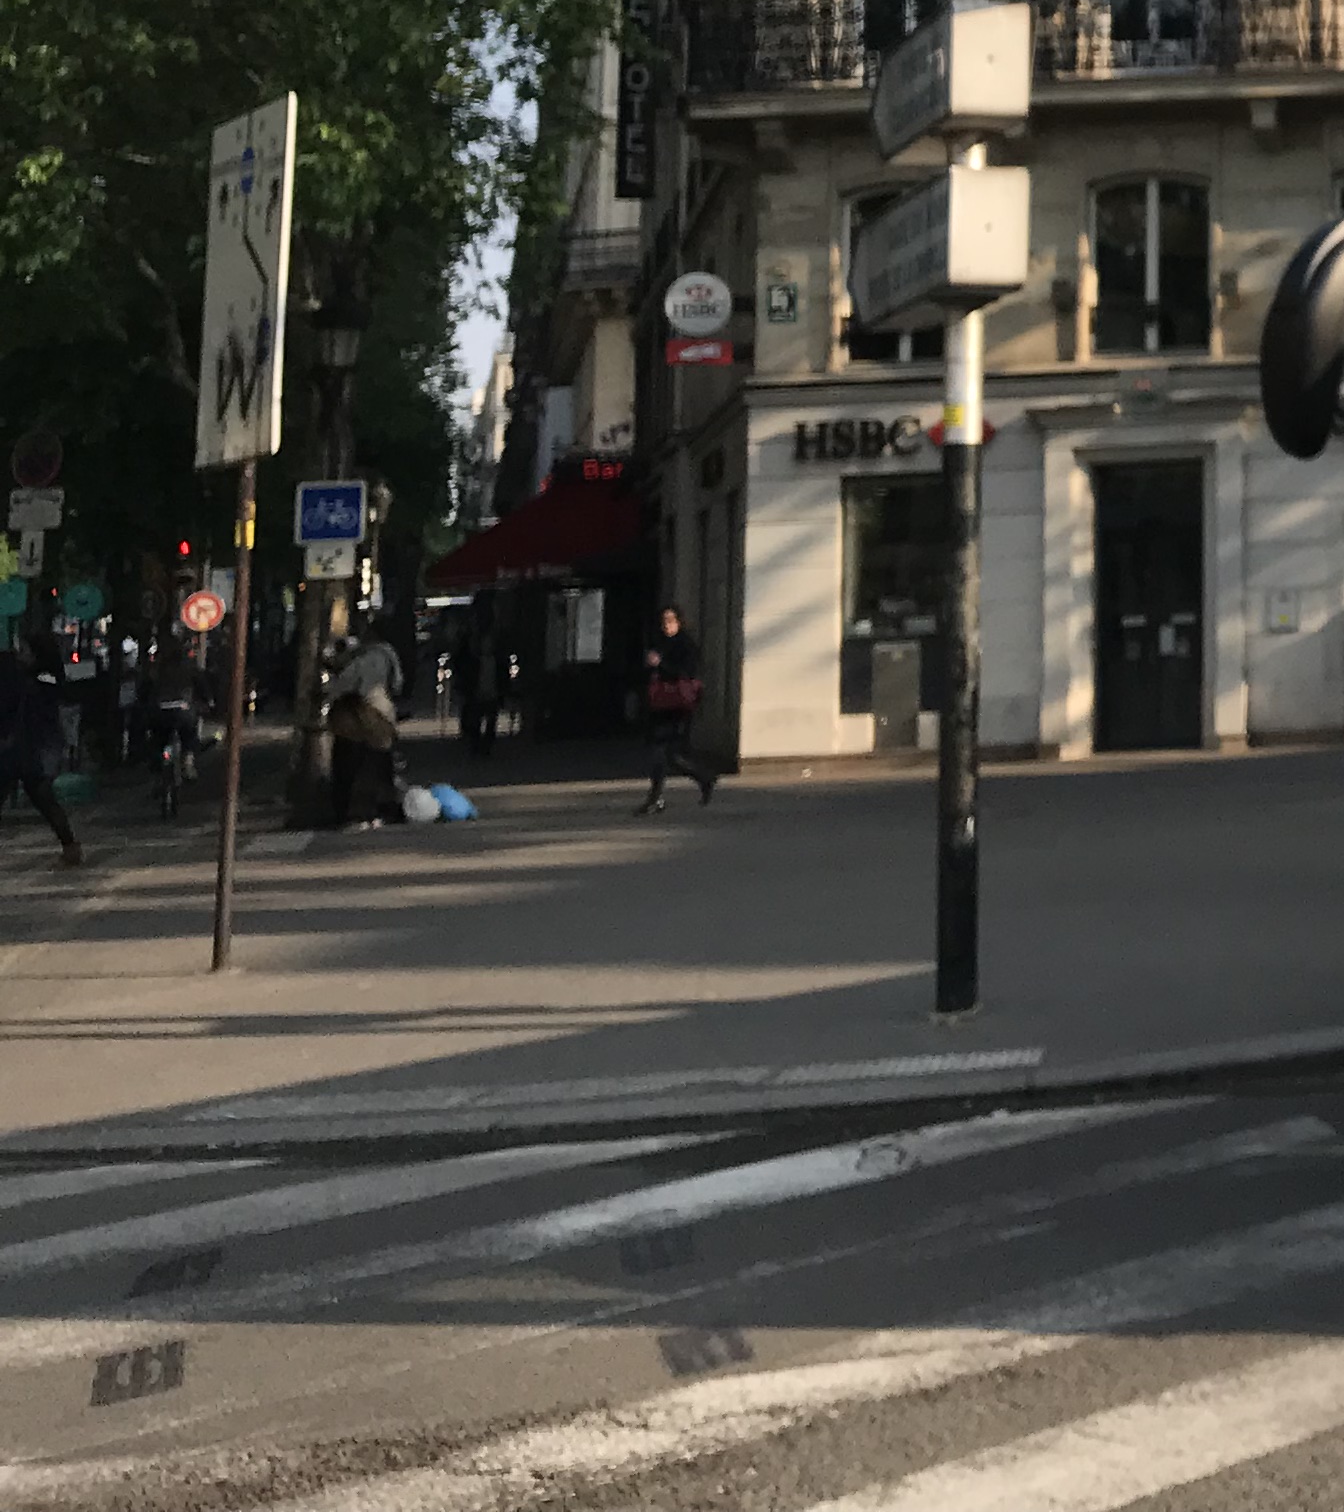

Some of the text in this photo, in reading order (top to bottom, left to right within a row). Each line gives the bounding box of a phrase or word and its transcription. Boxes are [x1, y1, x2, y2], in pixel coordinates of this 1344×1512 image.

[624, 61, 650, 184] OTEL
[794, 416, 921, 461] HSBC
[583, 458, 624, 480] Bar
